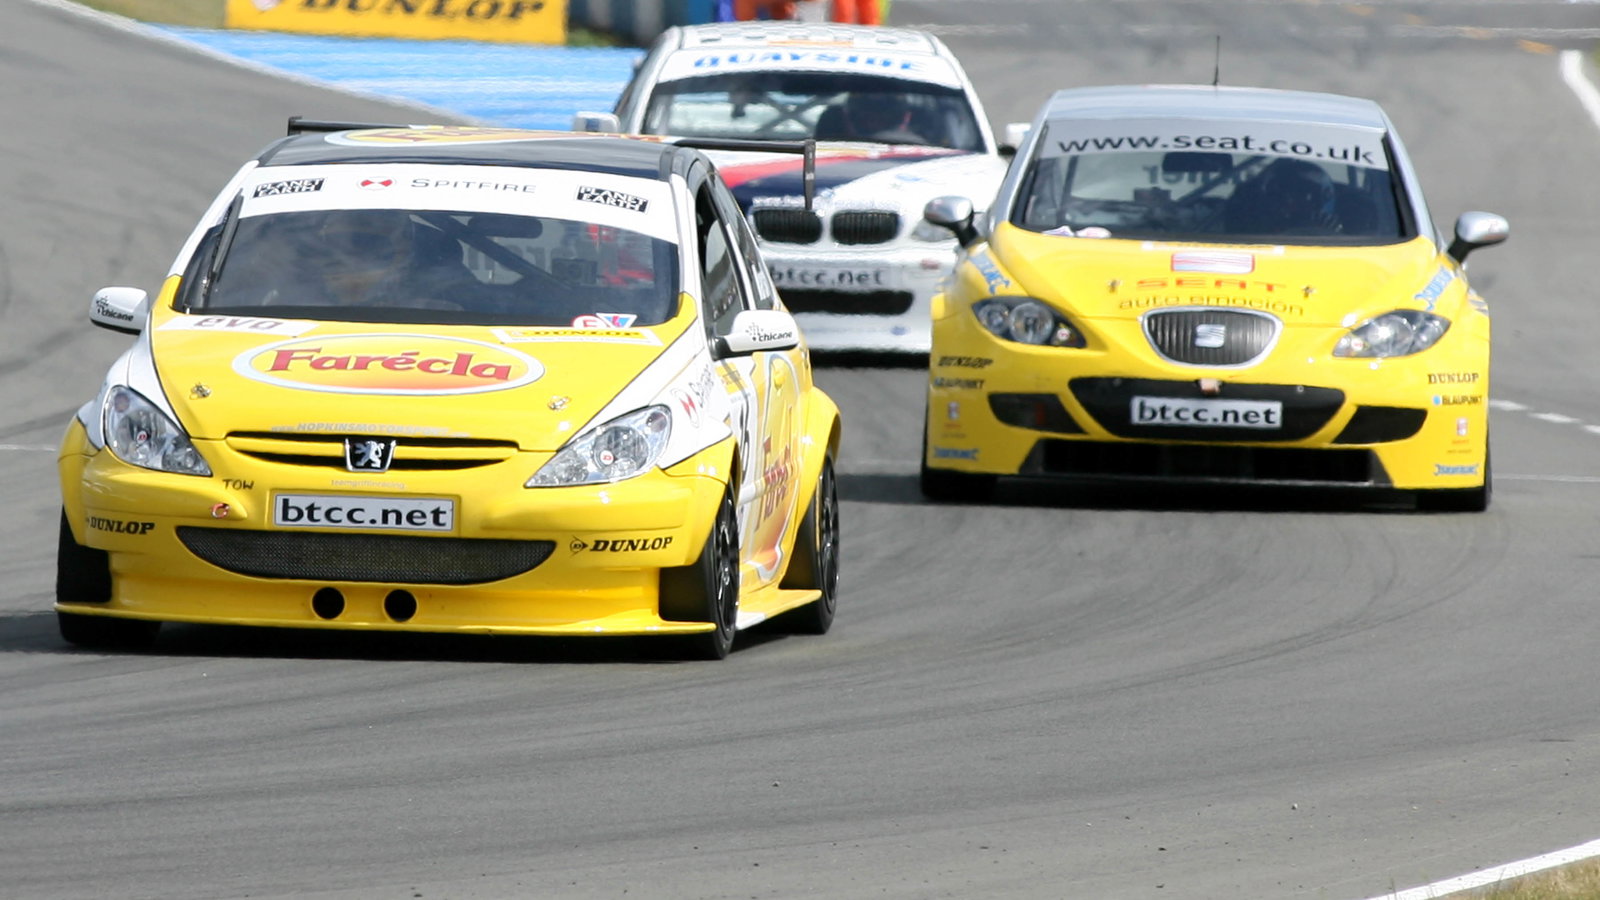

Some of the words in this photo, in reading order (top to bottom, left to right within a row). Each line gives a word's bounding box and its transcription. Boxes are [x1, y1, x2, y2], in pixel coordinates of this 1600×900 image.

[694, 52, 926, 74] QUAYSIDE
[1058, 133, 1375, 165] www.seat.co.uk
[769, 266, 885, 287] btcc.net
[1136, 278, 1286, 292] SEAT
[1119, 297, 1179, 309] auto
[758, 331, 793, 343] chicane
[267, 347, 514, 382] Farécla
[1427, 372, 1480, 385] DUNLOP
[1137, 400, 1277, 425] btcc.net
[222, 478, 255, 491] TOW
[280, 497, 448, 527] btcc.net
[89, 516, 156, 535] DUNLOP
[589, 536, 673, 553] DUNLOP
